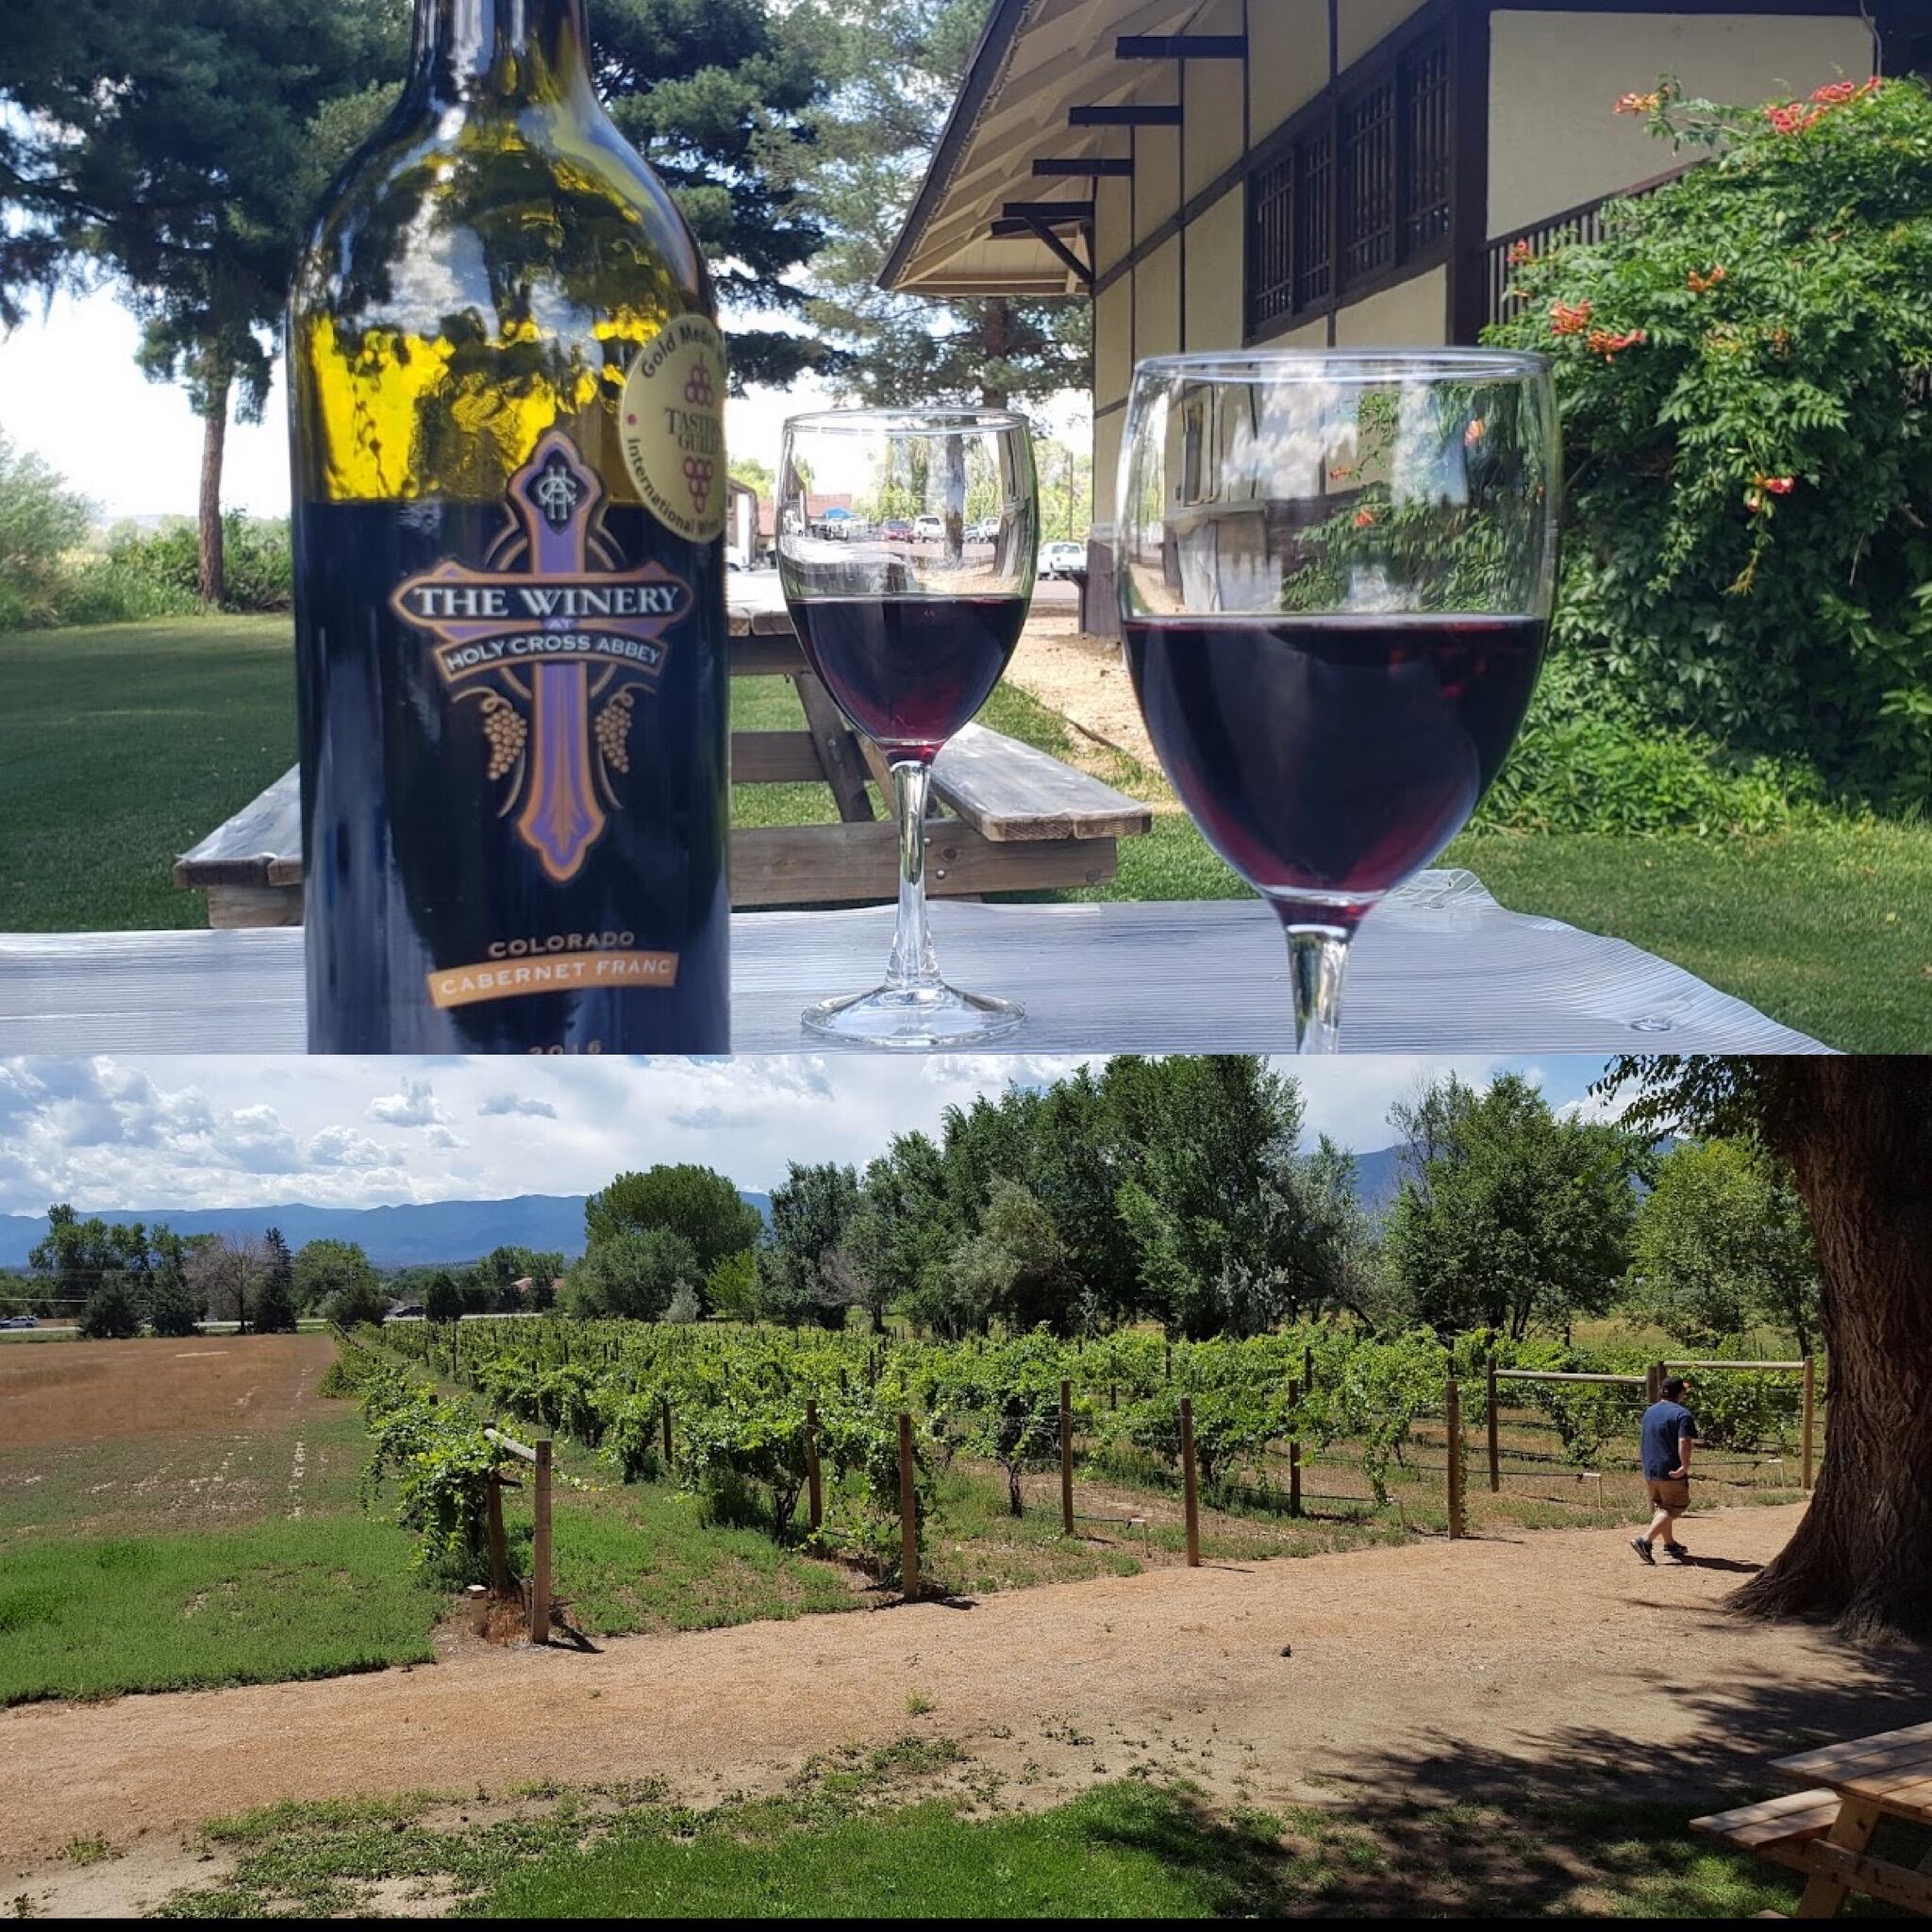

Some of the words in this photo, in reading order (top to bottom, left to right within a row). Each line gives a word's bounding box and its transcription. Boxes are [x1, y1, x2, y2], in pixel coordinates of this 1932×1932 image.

[641, 332, 676, 379] Gold
[626, 437, 695, 534] International
[413, 587, 509, 617] THE
[520, 586, 680, 617] WINERY
[549, 618, 575, 630] AT
[446, 640, 505, 672] HOLY
[509, 634, 591, 654] CROSS
[595, 637, 660, 664] ABBEY
[487, 930, 636, 958] COLORADO
[440, 961, 587, 995] CABERNET
[595, 958, 672, 976] FRANC
